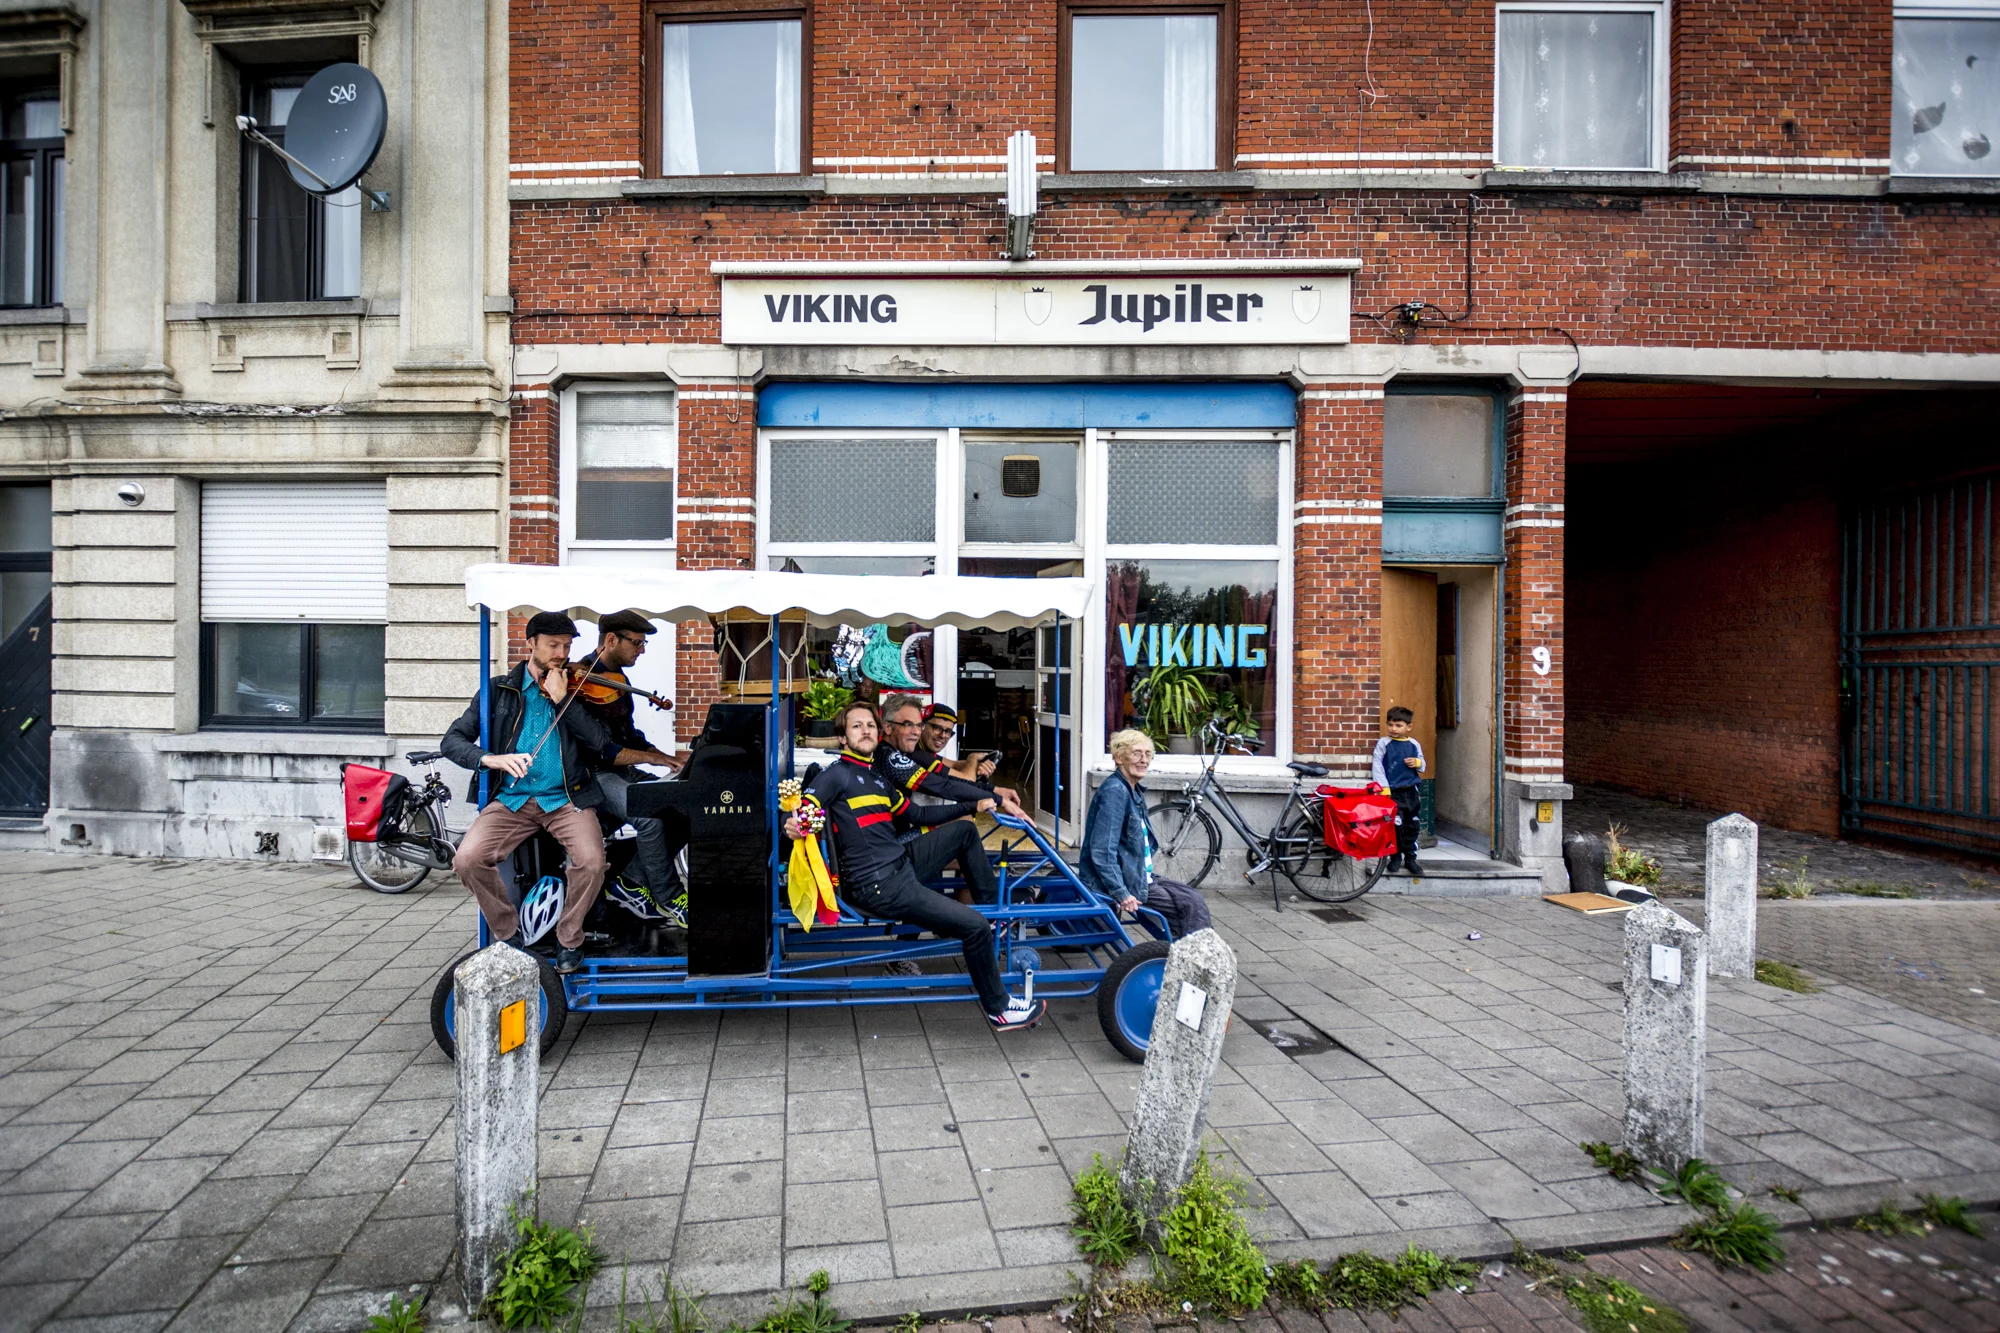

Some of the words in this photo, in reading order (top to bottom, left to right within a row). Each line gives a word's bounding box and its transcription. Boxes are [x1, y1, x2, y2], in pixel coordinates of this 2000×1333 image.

[328, 83, 357, 104] SAB
[764, 294, 897, 323] VIKING
[1078, 284, 1263, 333] Jupiler
[29, 626, 40, 641] 7
[1118, 622, 1268, 668] VIKING
[1532, 646, 1552, 676] 9
[703, 805, 752, 815] YAMAHA
